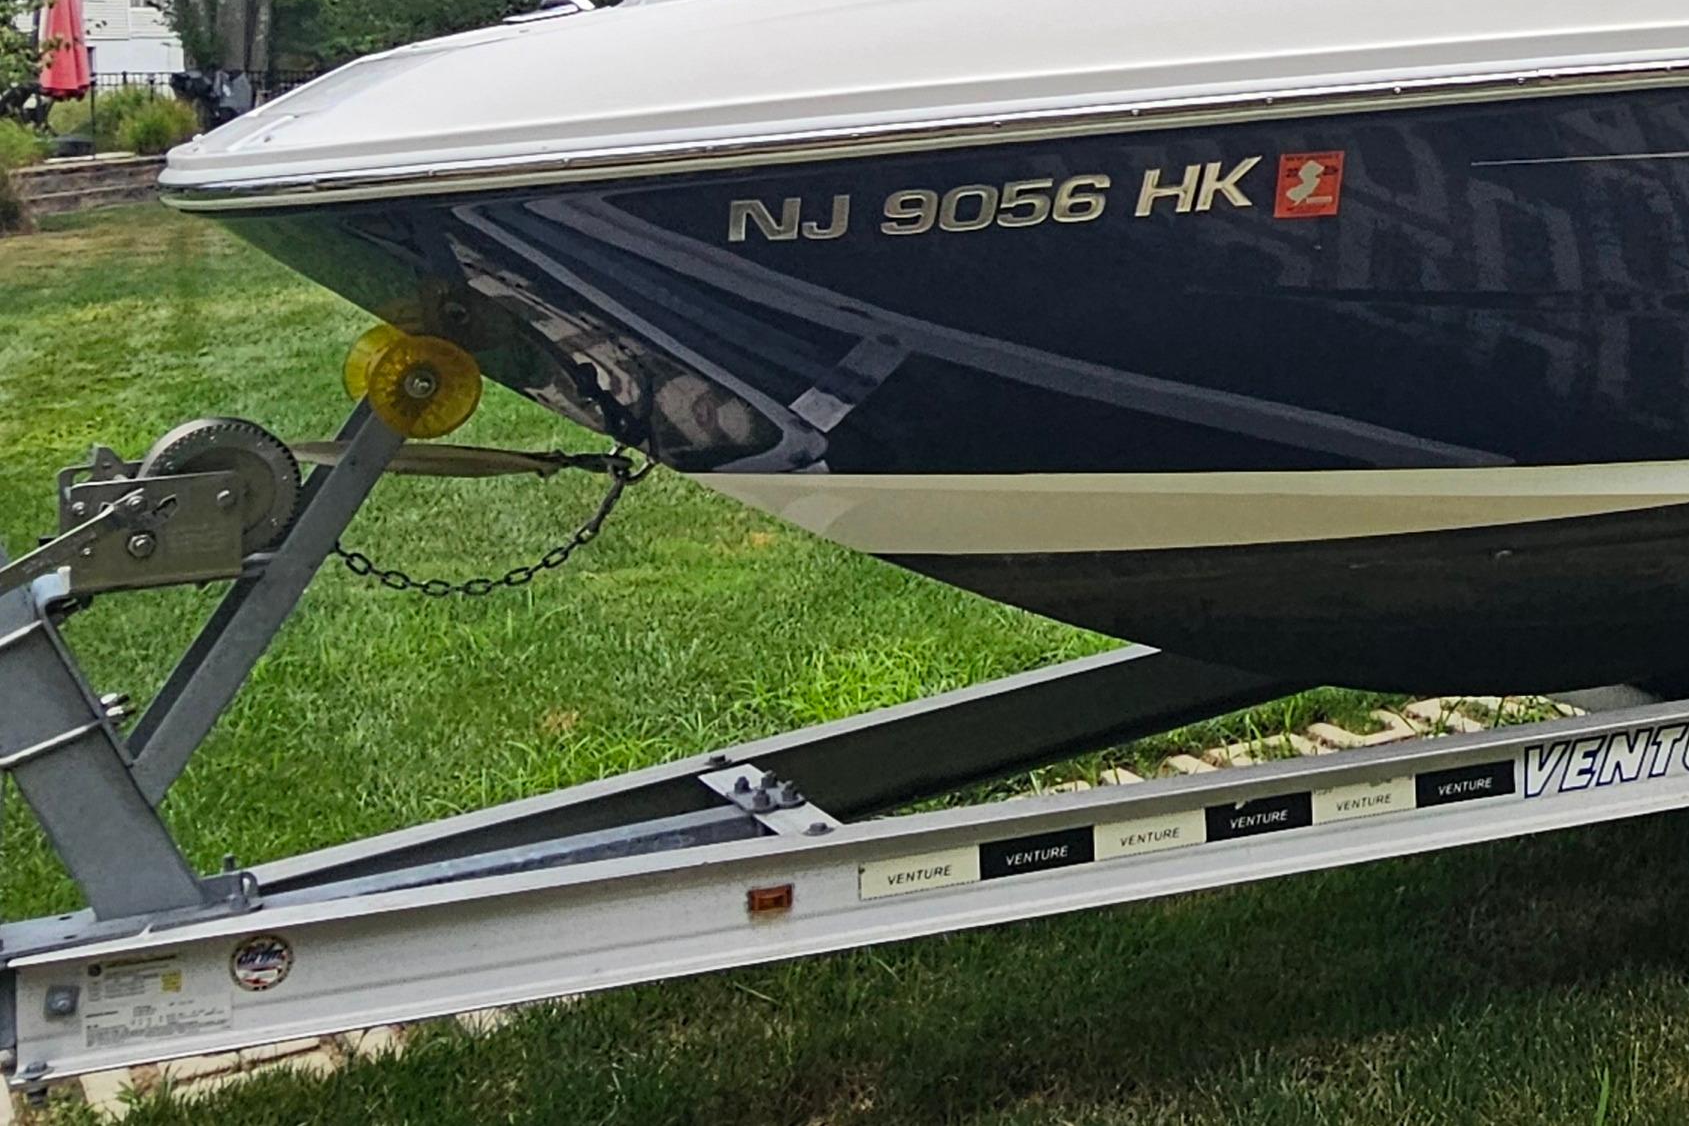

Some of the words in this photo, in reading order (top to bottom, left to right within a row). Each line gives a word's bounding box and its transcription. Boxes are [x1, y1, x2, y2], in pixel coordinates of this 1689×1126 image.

[727, 193, 850, 242] NJ
[880, 173, 1111, 236] 9056
[1134, 155, 1263, 217] HK
[887, 864, 953, 886] VENTURE
[1005, 844, 1069, 867] VENTURE
[1119, 826, 1181, 848] VENTURE
[1229, 808, 1289, 830] VENTURE
[1335, 792, 1392, 812] VENTURE
[1438, 776, 1493, 797] VENTURE
